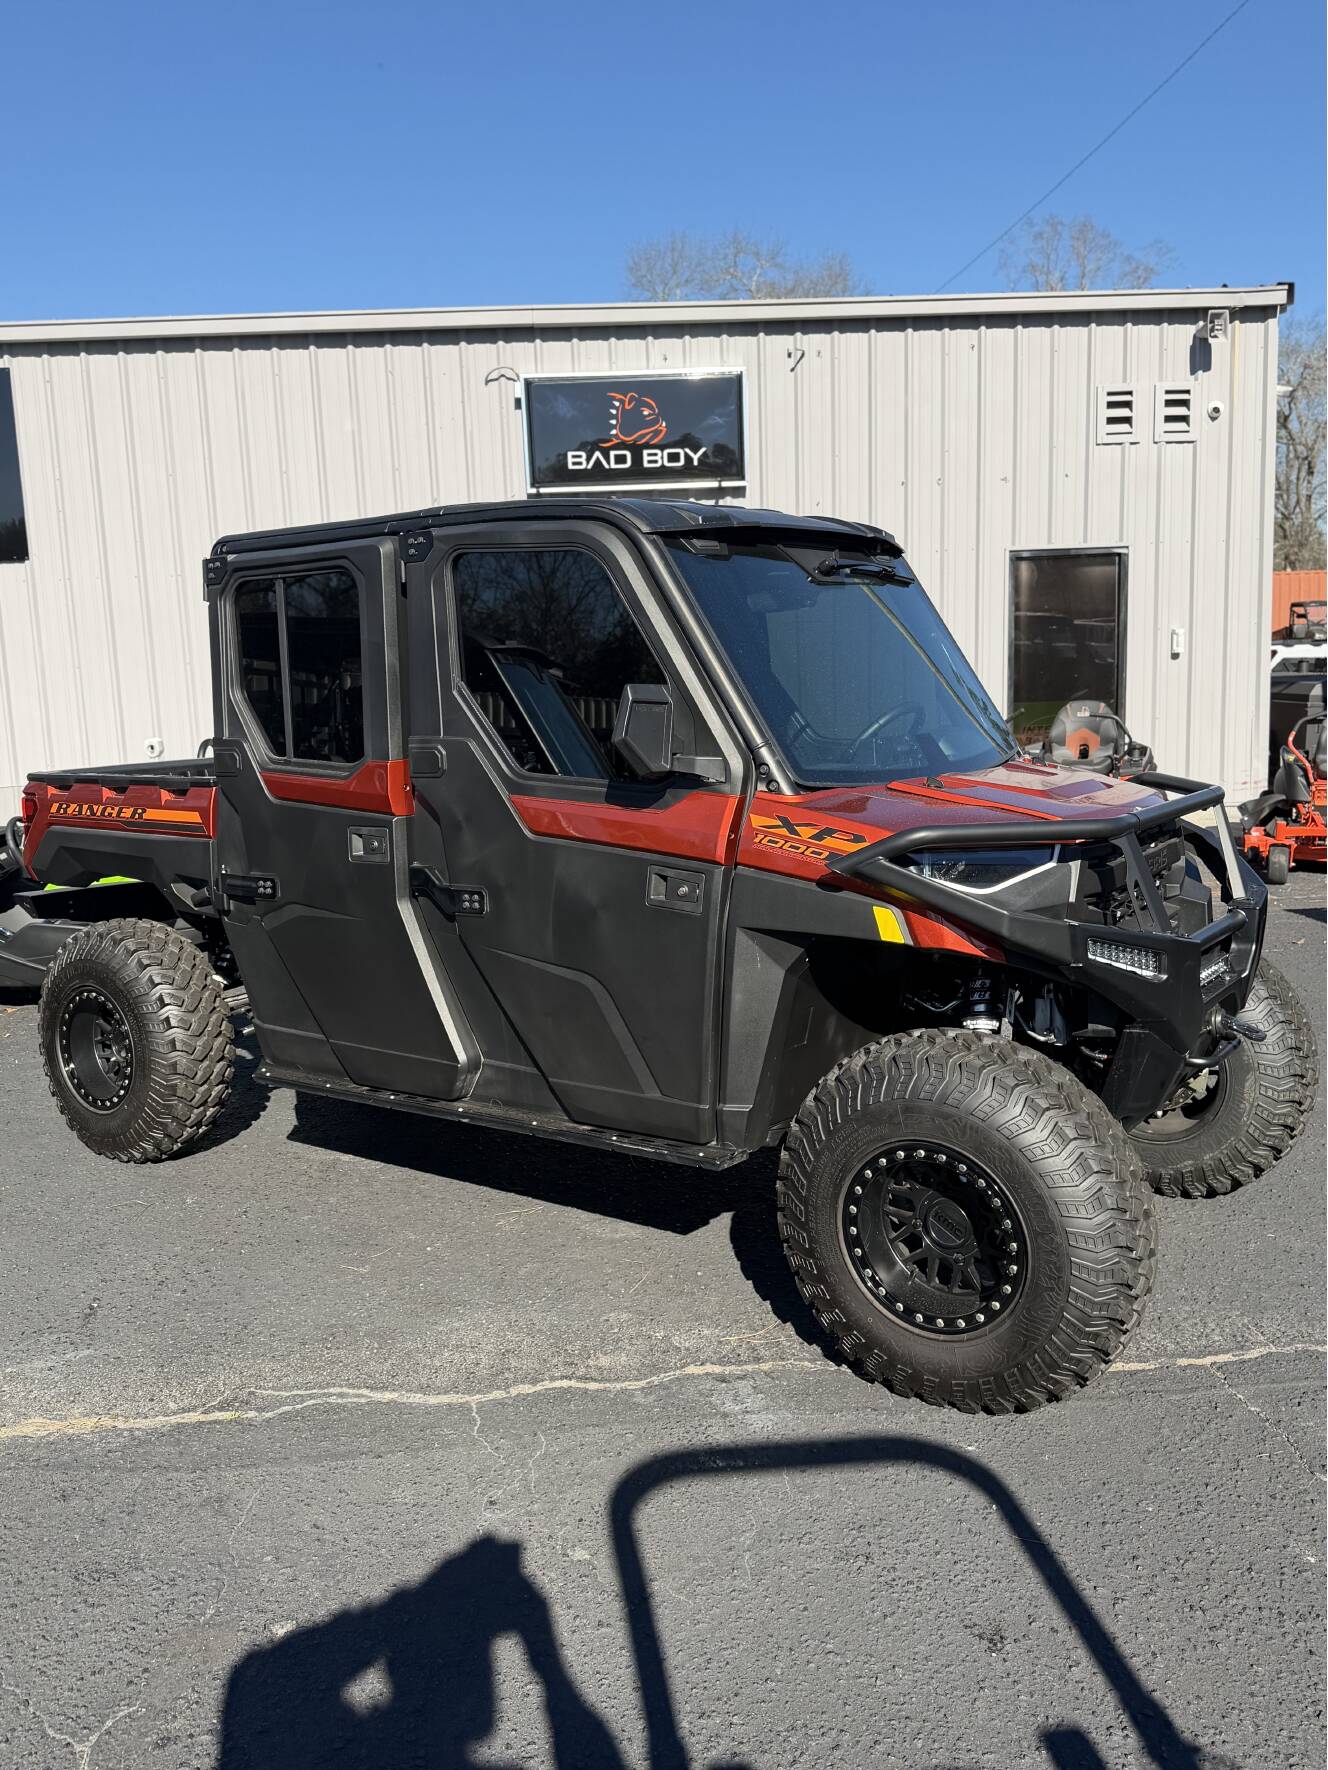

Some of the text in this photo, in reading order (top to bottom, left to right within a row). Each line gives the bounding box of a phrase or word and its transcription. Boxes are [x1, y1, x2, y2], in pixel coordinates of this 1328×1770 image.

[567, 447, 708, 470] BAD BOY
[54, 802, 148, 820] RANGER
[757, 813, 868, 843] XP
[752, 831, 830, 860] 1000
